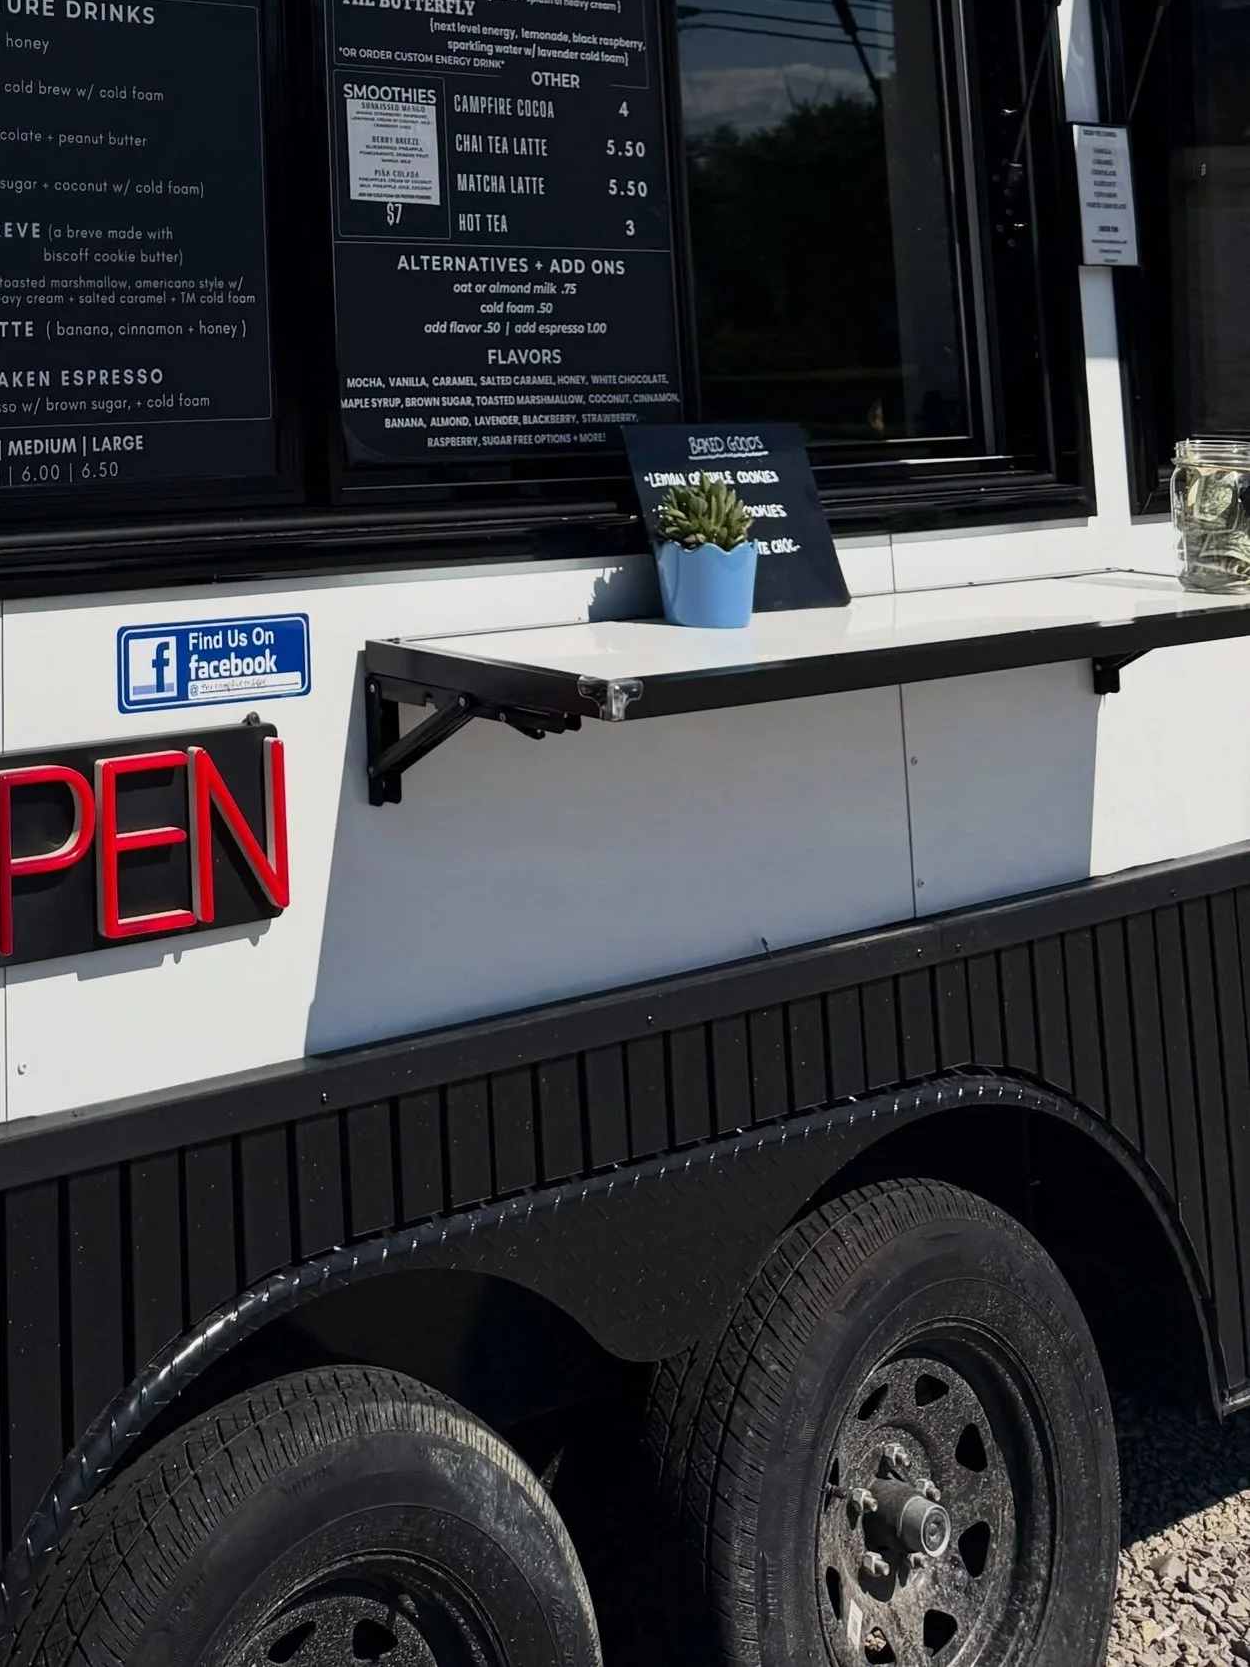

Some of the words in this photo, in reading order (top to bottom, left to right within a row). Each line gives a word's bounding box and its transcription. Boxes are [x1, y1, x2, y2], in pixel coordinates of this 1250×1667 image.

[66, 0, 154, 24] DRINKS
[6, 32, 49, 54] honey
[4, 79, 33, 94] cold
[39, 80, 71, 96] brew
[76, 84, 94, 101] w/
[99, 86, 127, 99] cold
[132, 86, 164, 101] foam
[531, 71, 580, 88] OTHER
[343, 83, 437, 103] SMOOTHIES
[454, 94, 512, 115] CAMPFIRE
[517, 99, 554, 118] COCOA
[619, 101, 629, 117] 4
[59, 134, 103, 147] peanut
[108, 132, 147, 146] butter
[456, 134, 482, 153] CHAI
[487, 136, 509, 154] TEA
[513, 137, 547, 156] LATTE
[606, 139, 645, 157] 5.50
[457, 173, 506, 193] MATCHA
[510, 176, 545, 195] LATTE
[608, 179, 647, 197] 5.50
[386, 202, 403, 227] $7
[459, 213, 481, 231] HOT
[486, 214, 508, 232] TEA
[626, 220, 635, 236] 3
[397, 255, 528, 272] ALTERNATIVES
[535, 260, 543, 270] +
[550, 259, 585, 274] ADD
[591, 259, 625, 275] ONS
[453, 282, 472, 293] oat
[475, 284, 487, 293] or
[488, 281, 531, 294] almond
[533, 282, 557, 294] milk
[561, 283, 577, 294] .75
[488, 349, 561, 364] FLAVORS
[61, 368, 163, 386] ESPRESSO
[347, 377, 385, 388] MOCHA,
[388, 377, 429, 388] VANILLA,
[432, 376, 477, 387] CARAMEL,
[480, 376, 512, 386] SALTED
[513, 375, 556, 385] CARAMEL,
[557, 375, 589, 385] HONEY,
[590, 375, 617, 384] WHITE
[618, 374, 669, 384] CHOCOLATE,
[8, 438, 77, 456] MEDIUM
[93, 435, 143, 452] LARGE
[688, 436, 724, 454] BAKED
[727, 436, 763, 452] GOODS
[22, 464, 60, 482] 6.00
[81, 461, 118, 478] 6.50
[189, 630, 223, 651] Find
[228, 629, 248, 648] Us
[252, 627, 274, 645] On
[188, 648, 278, 680] facebook
